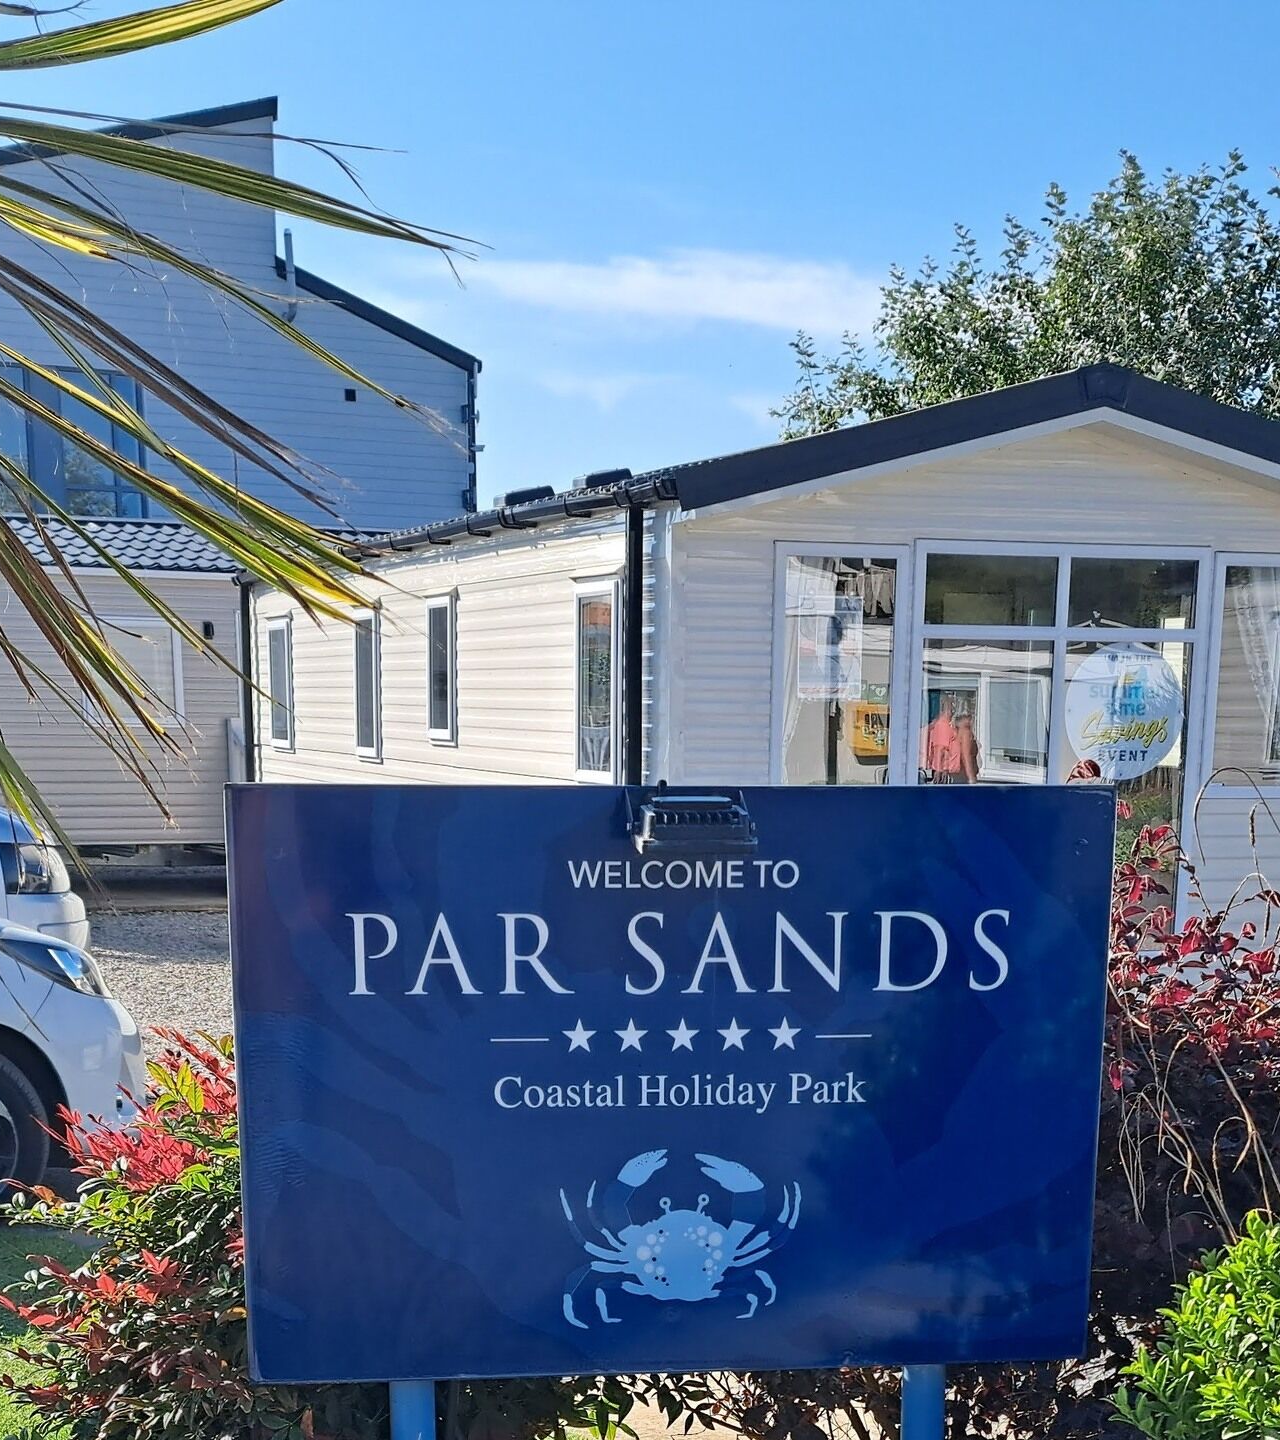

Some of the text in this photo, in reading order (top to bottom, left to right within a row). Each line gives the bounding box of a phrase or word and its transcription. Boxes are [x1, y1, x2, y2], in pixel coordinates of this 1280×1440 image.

[1089, 682, 1163, 699] summe
[1080, 710, 1168, 751] Savings
[1098, 749, 1148, 762] EVENT
[567, 859, 801, 889] WELCOME TO
[344, 908, 1011, 996] PAR SANDS
[493, 1071, 868, 1114] Coastal Holiday Park
